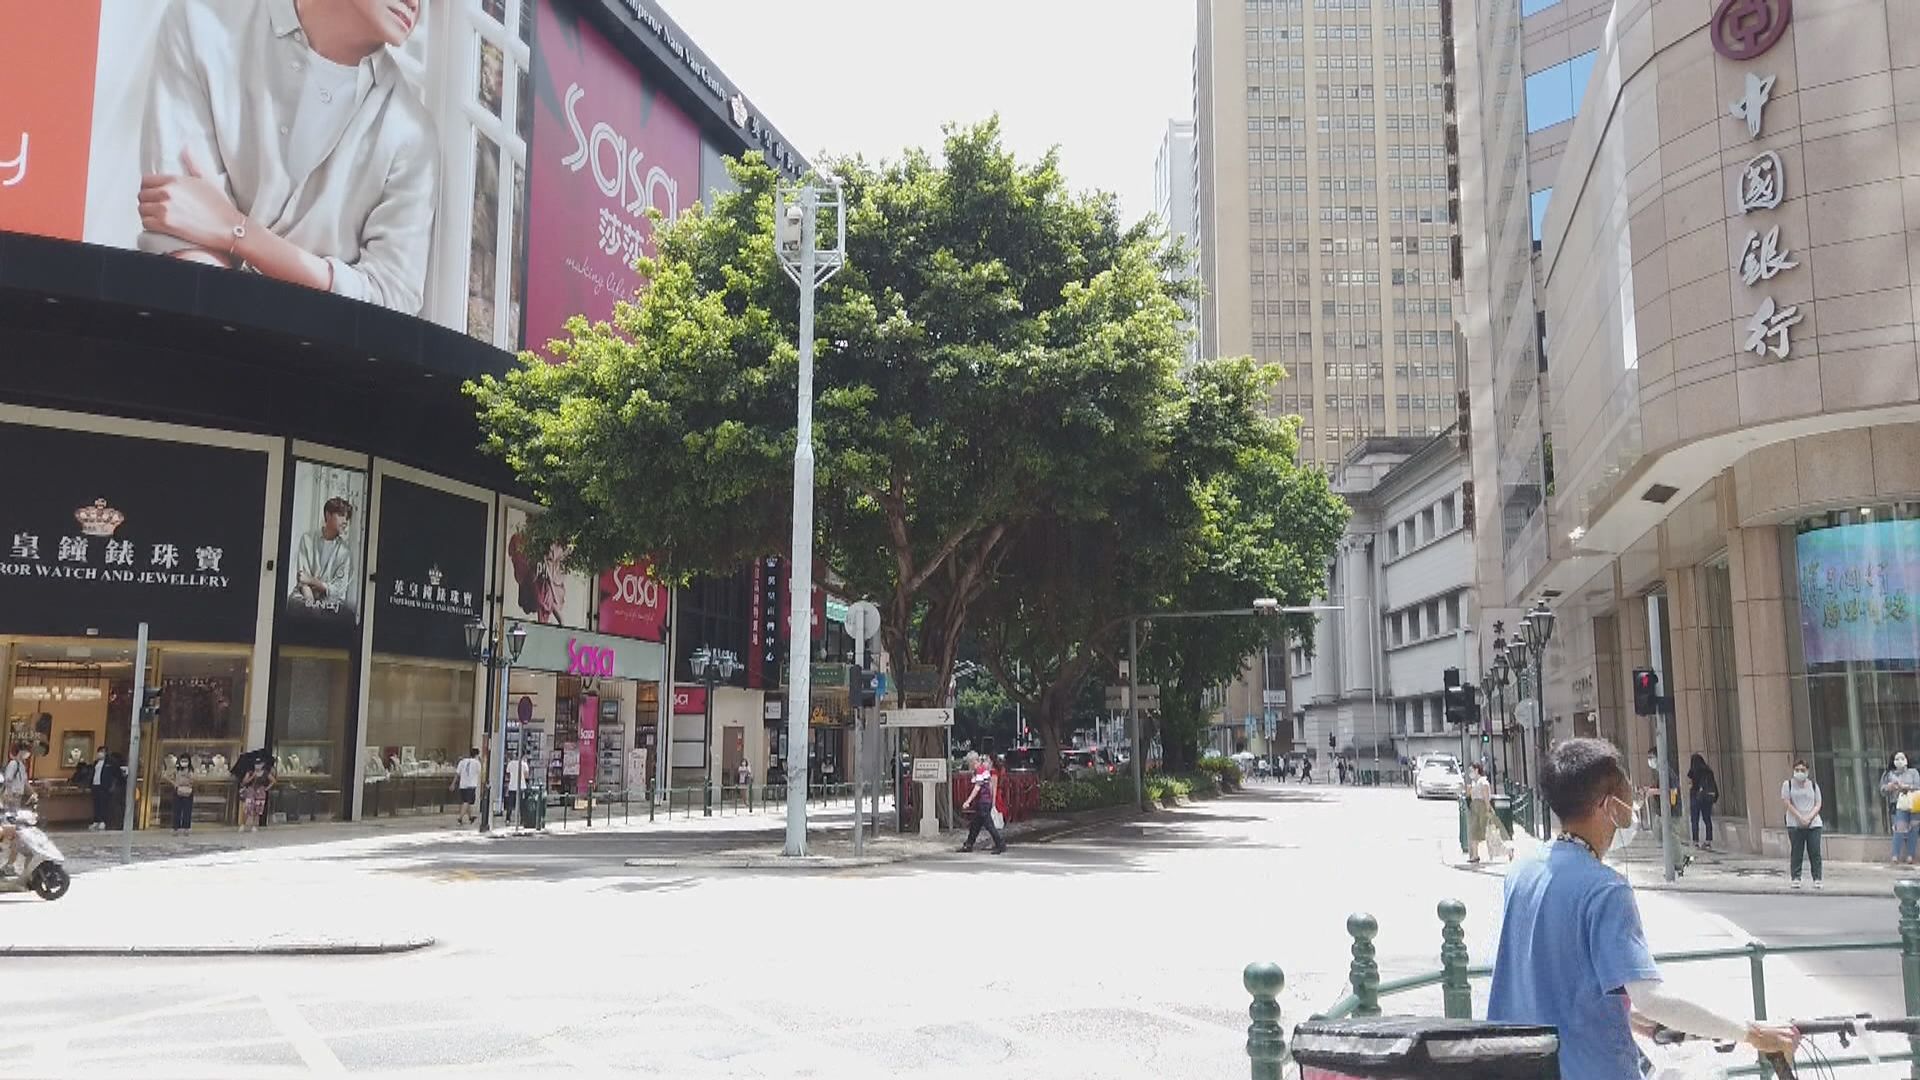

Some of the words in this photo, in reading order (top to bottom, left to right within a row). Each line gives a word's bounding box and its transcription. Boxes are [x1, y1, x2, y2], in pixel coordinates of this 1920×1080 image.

[1729, 71, 1804, 359] 中國銀行
[599, 208, 644, 272] 莎莎
[565, 256, 605, 296] making
[10, 532, 224, 572] 皇鐘錶珠寶
[36, 564, 97, 580] WATCH
[101, 568, 134, 582] AND
[137, 571, 230, 588] JEWELLERY
[612, 566, 658, 609] Sasa
[567, 637, 616, 678] Sasa
